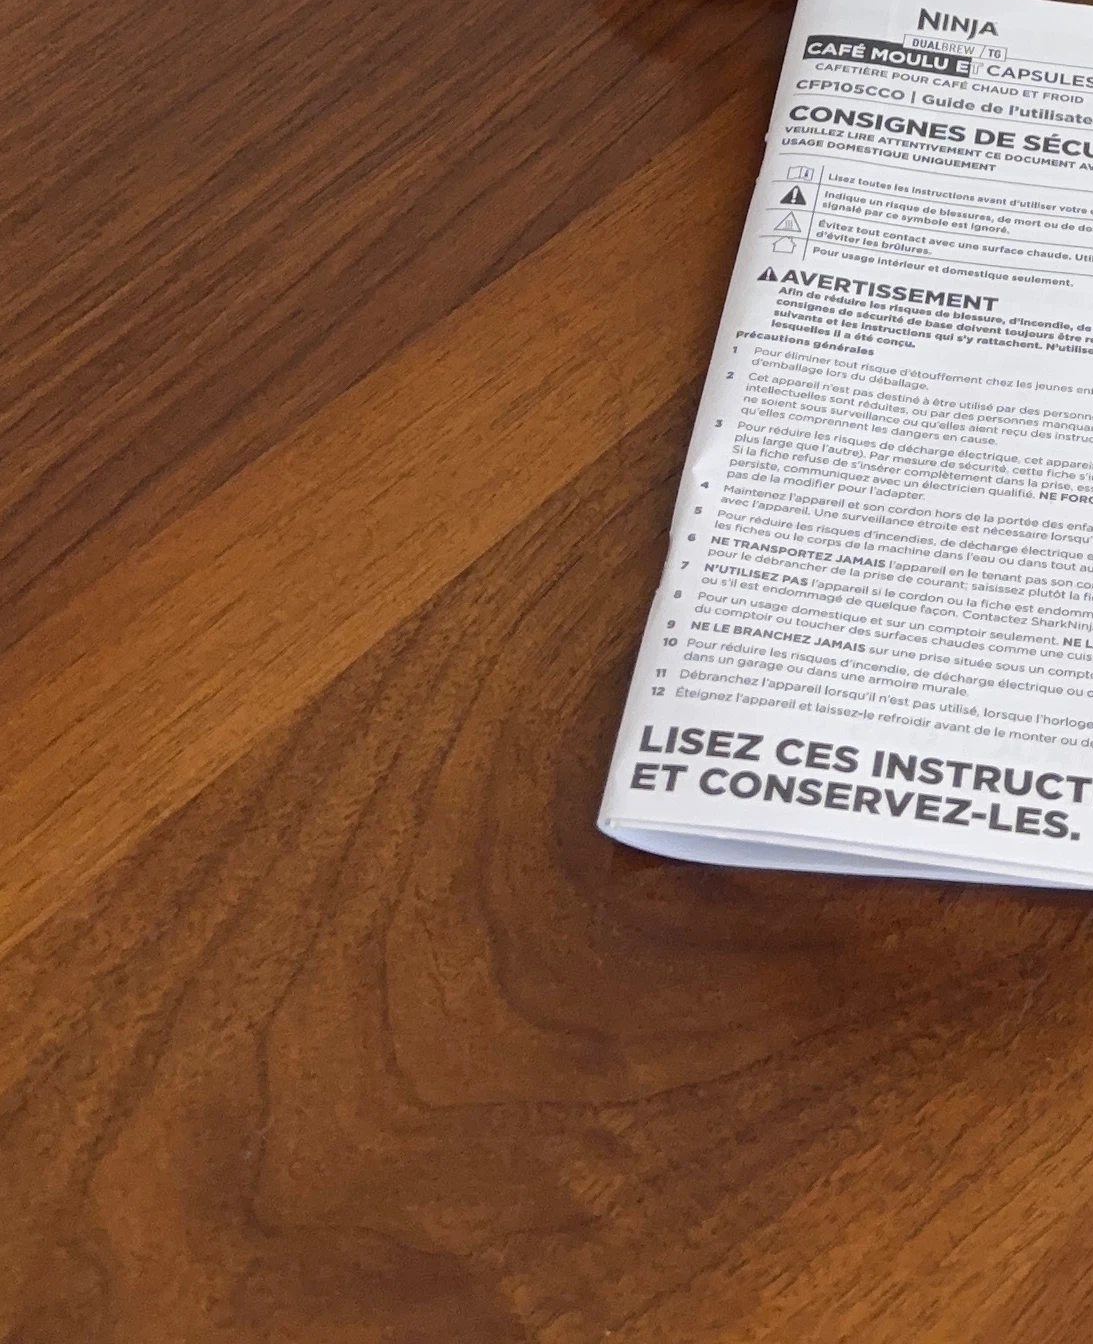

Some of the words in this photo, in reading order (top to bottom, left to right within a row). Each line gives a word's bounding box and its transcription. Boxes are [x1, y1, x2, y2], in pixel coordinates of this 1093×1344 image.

[917, 8, 998, 39] NINJA
[807, 42, 865, 60] CAFÉ
[871, 48, 949, 72] MOULU
[912, 38, 975, 55] DUALBREW
[988, 47, 1001, 59] TG
[796, 79, 905, 100] CFP105CCO
[922, 94, 976, 111] Guide
[980, 102, 1004, 114] de
[815, 62, 888, 79] CAFETIÈRE
[891, 72, 929, 84] POUR
[932, 78, 968, 90] CAFÉ
[971, 80, 1020, 96] CHAUD
[1022, 85, 1040, 99] ET
[1042, 87, 1086, 104] FROID
[785, 126, 845, 138] VEUILLEZ
[847, 131, 875, 142] LIRE
[878, 136, 982, 158] ATTENTIVEMENT
[984, 151, 1002, 160] CE
[1004, 153, 1076, 169] DOCUMENT
[789, 105, 966, 142] CONSIGNES
[974, 128, 1016, 149] DE
[782, 138, 824, 148] USAGE
[826, 141, 910, 160] DOMESTIQUE
[912, 154, 997, 172] UNIQUEMENT
[828, 173, 856, 184] Lisez
[858, 178, 892, 190] toutes
[894, 183, 909, 193] les
[911, 186, 975, 202] instructions
[977, 196, 1007, 206] avant
[1009, 199, 1057, 211] d'utiliser
[1059, 206, 1088, 214] votre
[820, 201, 862, 215] signalé
[864, 208, 884, 217] par
[886, 212, 899, 220] ce
[901, 210, 949, 227] symbole
[970, 222, 1010, 234] ignoré.
[814, 230, 860, 244] d'éviter
[862, 236, 879, 248] les
[881, 237, 932, 255] brûlures.
[812, 246, 840, 257] Pour
[841, 252, 875, 264] usage
[877, 256, 926, 271] intérieur
[928, 265, 940, 273] et
[942, 266, 1009, 281] domestique
[1012, 275, 1074, 287] seulement.
[780, 269, 999, 312] AVERTISSEMENT
[736, 330, 810, 346] Précautions
[813, 340, 874, 356] générales
[751, 358, 824, 375] d'emballage
[826, 367, 848, 379] lors
[850, 372, 866, 382] du
[868, 373, 928, 390] déballage.
[667, 620, 676, 630] 9
[690, 620, 711, 632] NE
[712, 623, 731, 634] LE
[732, 625, 812, 645] BRANCHEZ
[813, 637, 866, 653] JAMAIS
[868, 646, 890, 655] sur
[892, 649, 916, 659] une
[918, 653, 951, 664] prise
[954, 656, 993, 669] située
[996, 662, 1025, 673] sous
[1028, 666, 1045, 674] un
[651, 687, 665, 697] 12
[675, 686, 733, 702] Éteignez
[735, 692, 796, 709] l'appareil
[798, 702, 813, 712] et
[815, 702, 875, 720] laissez-le
[878, 713, 932, 728] refroidir
[934, 721, 971, 734] avant
[973, 725, 991, 736] de
[994, 726, 1006, 738] le
[1008, 731, 1058, 744] monter
[1060, 737, 1078, 746] ou
[656, 669, 667, 678] 11
[679, 668, 759, 686] Débranchez
[761, 677, 822, 694] l'appareil
[824, 685, 876, 702] lorsqu'il
[878, 694, 910, 707] n'est
[912, 700, 936, 710] pas
[939, 703, 980, 717] utilisé,
[983, 707, 1033, 723] lorsque
[1036, 713, 1093, 730] l'horloge
[639, 725, 764, 762] LISEZ
[775, 738, 860, 774] CES
[630, 762, 688, 792] ET
[699, 768, 1080, 841] CONSERVEZ-LES.
